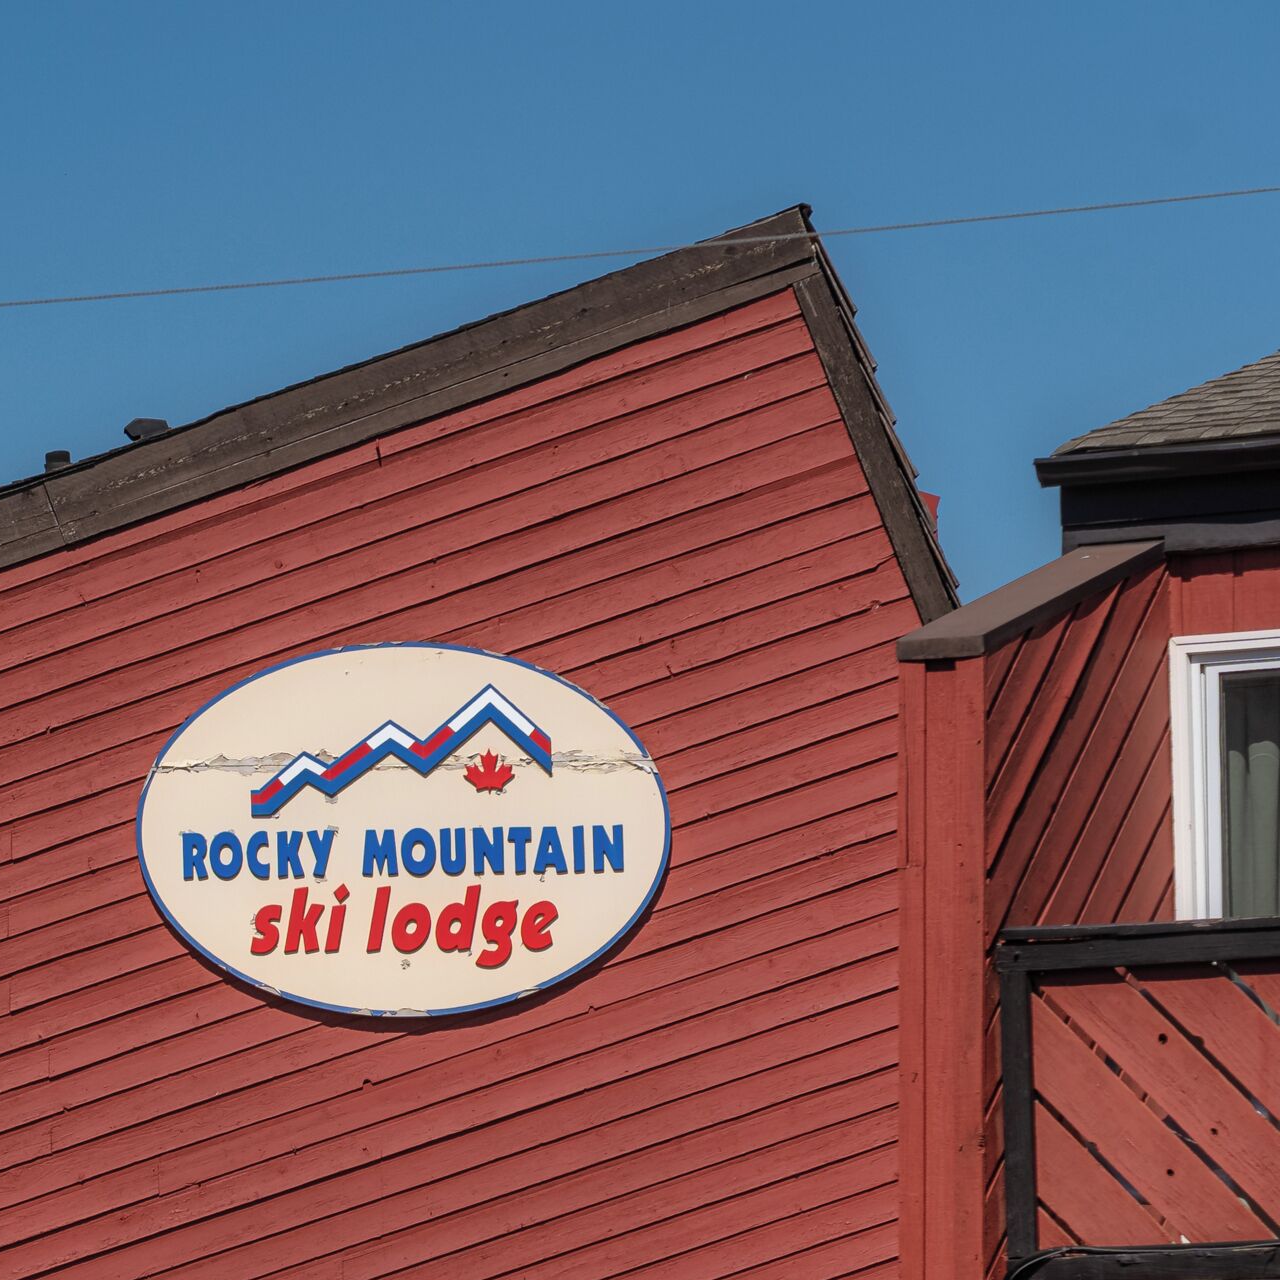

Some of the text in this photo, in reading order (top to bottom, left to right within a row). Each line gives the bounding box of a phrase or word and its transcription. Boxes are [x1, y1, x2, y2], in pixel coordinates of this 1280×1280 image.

[180, 824, 625, 880] ROCKY MOUNTAIN
[248, 882, 559, 968] ski lodge
